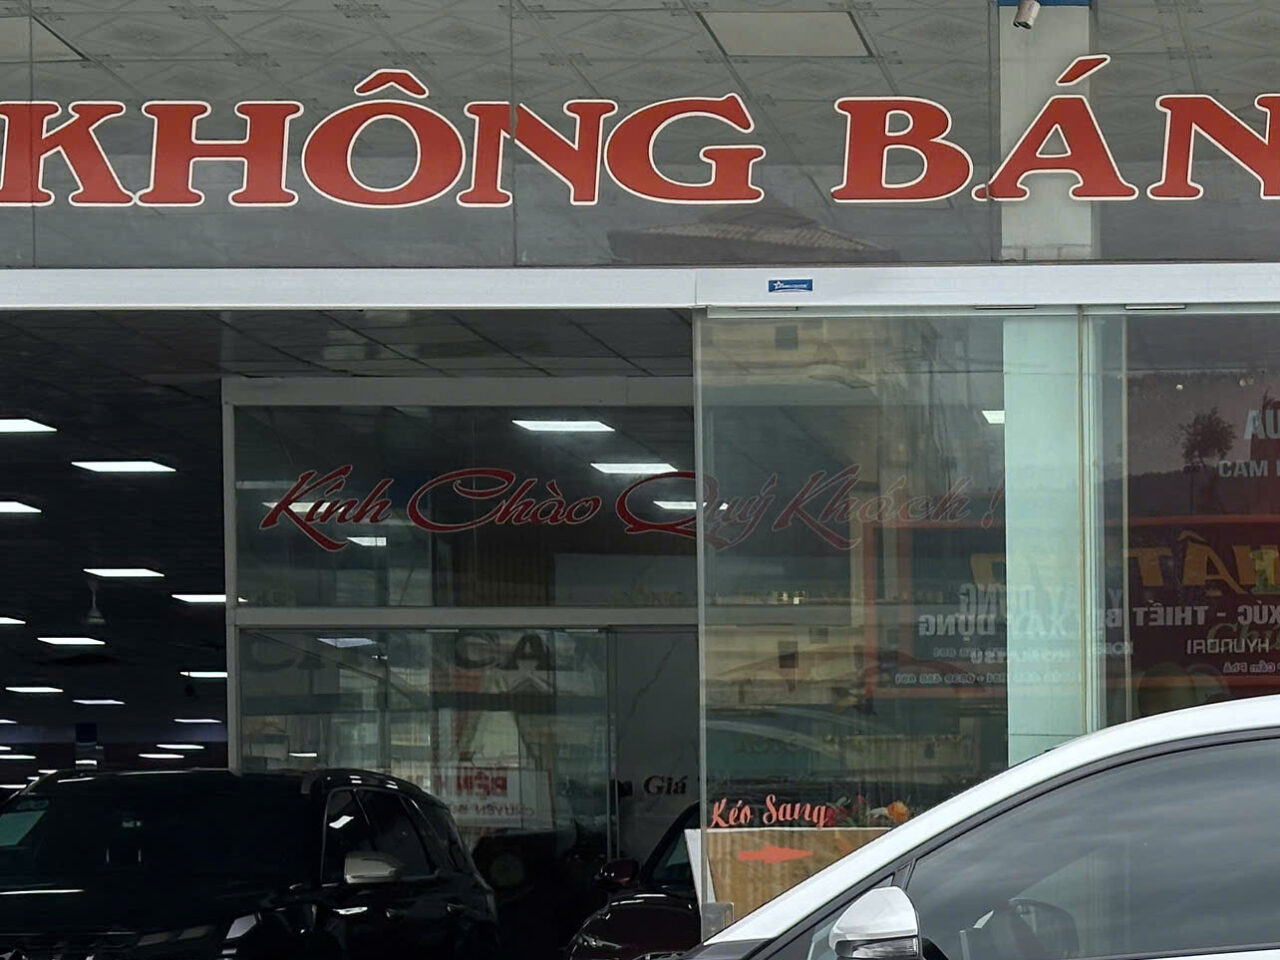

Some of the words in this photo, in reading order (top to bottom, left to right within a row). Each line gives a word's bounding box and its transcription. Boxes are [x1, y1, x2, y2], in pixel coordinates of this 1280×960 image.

[0, 69, 764, 209] KHÔNG
[1218, 459, 1269, 477] CAM
[259, 463, 394, 552] Kính
[407, 467, 602, 533] Chào
[615, 471, 777, 550] Quý
[771, 464, 972, 550] Khách
[643, 774, 689, 795] Giá
[762, 793, 829, 830] Sang
